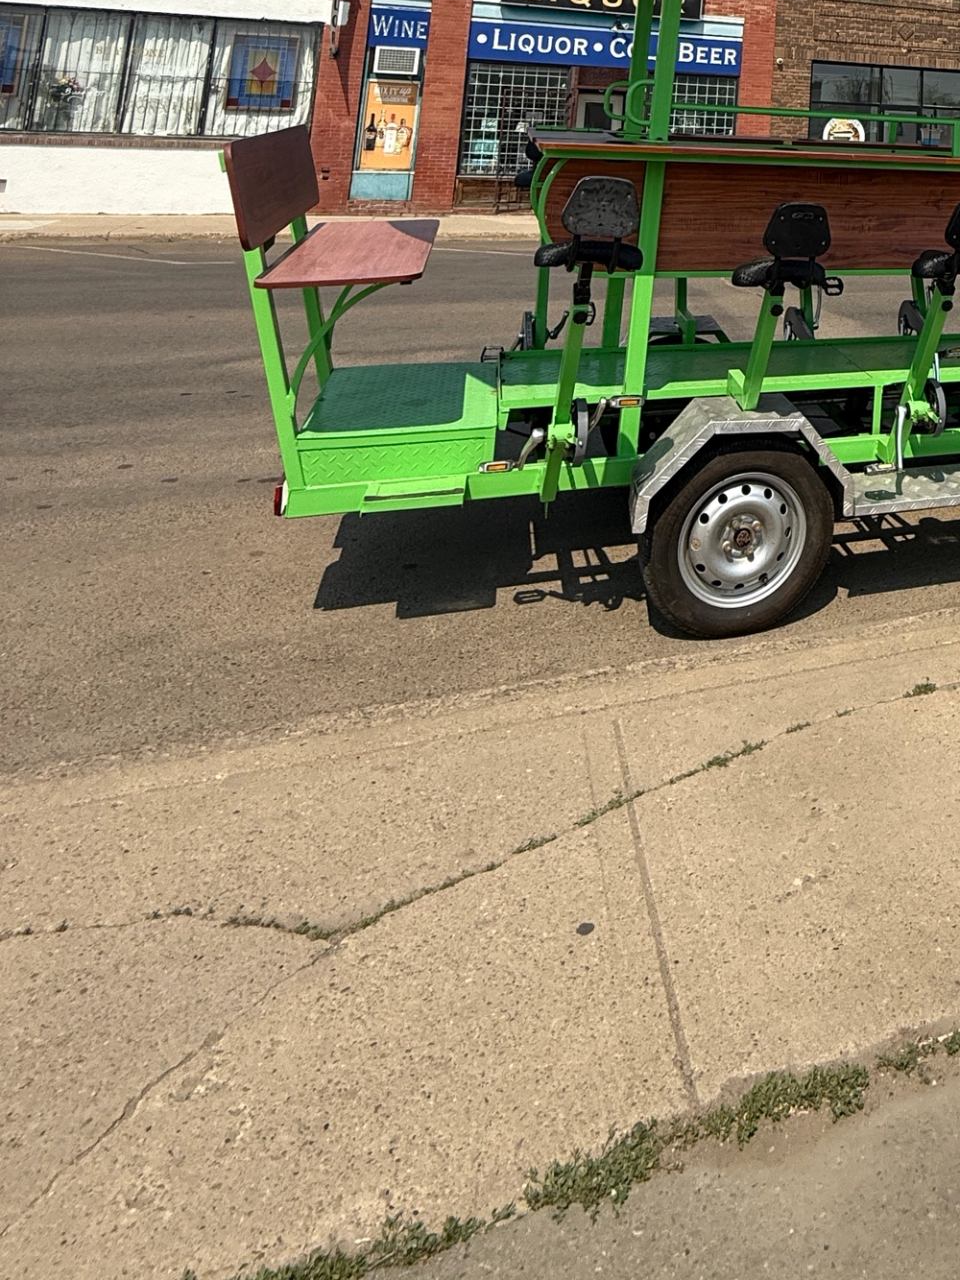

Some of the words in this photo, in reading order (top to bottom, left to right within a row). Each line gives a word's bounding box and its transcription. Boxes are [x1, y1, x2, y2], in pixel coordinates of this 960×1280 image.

[371, 14, 428, 40] WINE
[491, 28, 588, 56] LIQUOR
[678, 41, 737, 66] BEER
